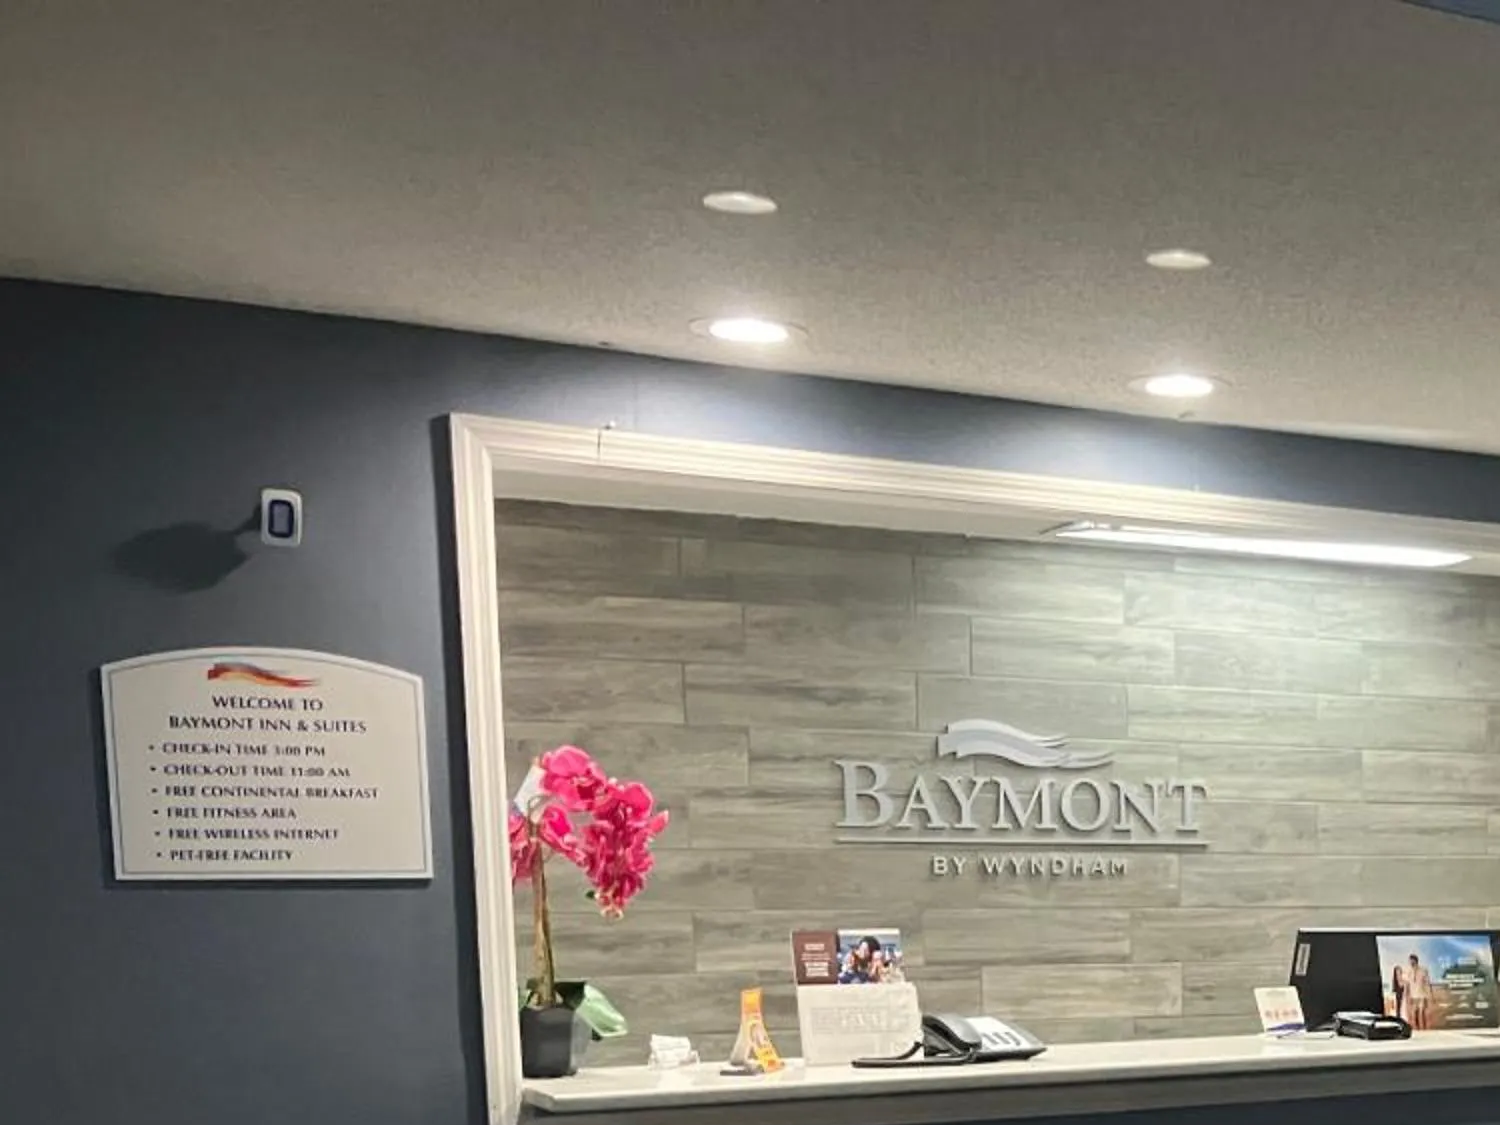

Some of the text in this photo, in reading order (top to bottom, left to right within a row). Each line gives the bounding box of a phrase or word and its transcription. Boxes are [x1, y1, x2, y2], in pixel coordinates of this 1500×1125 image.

[211, 695, 323, 711] WELCOME TO
[168, 715, 367, 733] BAYMONT INN & SUITES
[162, 743, 231, 755] CHECK-IN
[235, 744, 268, 756] TIME
[305, 746, 325, 757] PM
[163, 763, 247, 777] CHECK-OUT
[253, 765, 284, 777] TIME
[327, 767, 351, 777] AM
[165, 785, 378, 798] FREE CONTINENTAL BREAKFAST
[832, 759, 1210, 834] BAYMONT
[167, 806, 297, 819] FREE FITNESS AREA
[168, 828, 339, 840] FREE WIRELESS INTERNET
[170, 849, 293, 861] PET-FREE FACILITY
[931, 856, 1131, 878] BY WYNDHAM
